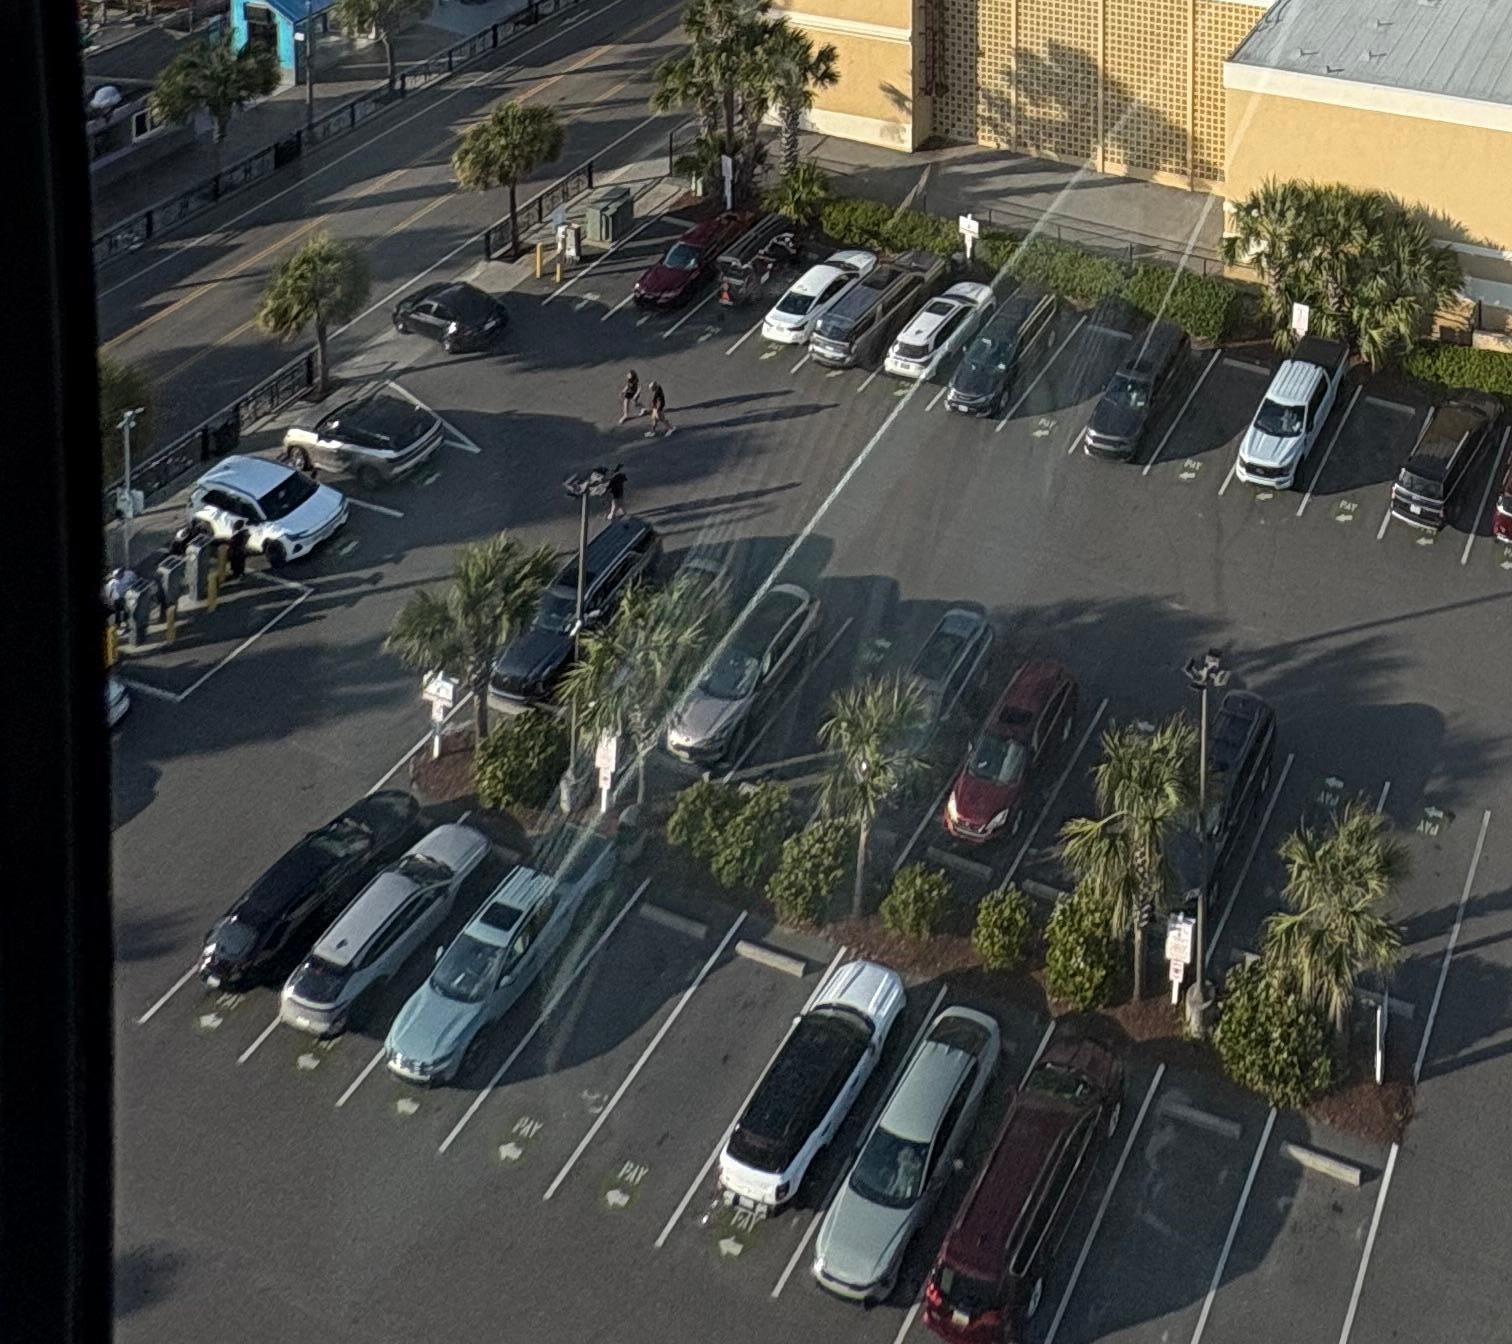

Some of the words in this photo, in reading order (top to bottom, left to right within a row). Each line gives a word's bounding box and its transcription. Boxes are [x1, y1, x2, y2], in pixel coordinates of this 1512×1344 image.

[1184, 458, 1203, 471] PAY
[1340, 499, 1358, 512] PAY
[512, 1116, 545, 1138] PAY
[617, 1160, 649, 1185] PAY
